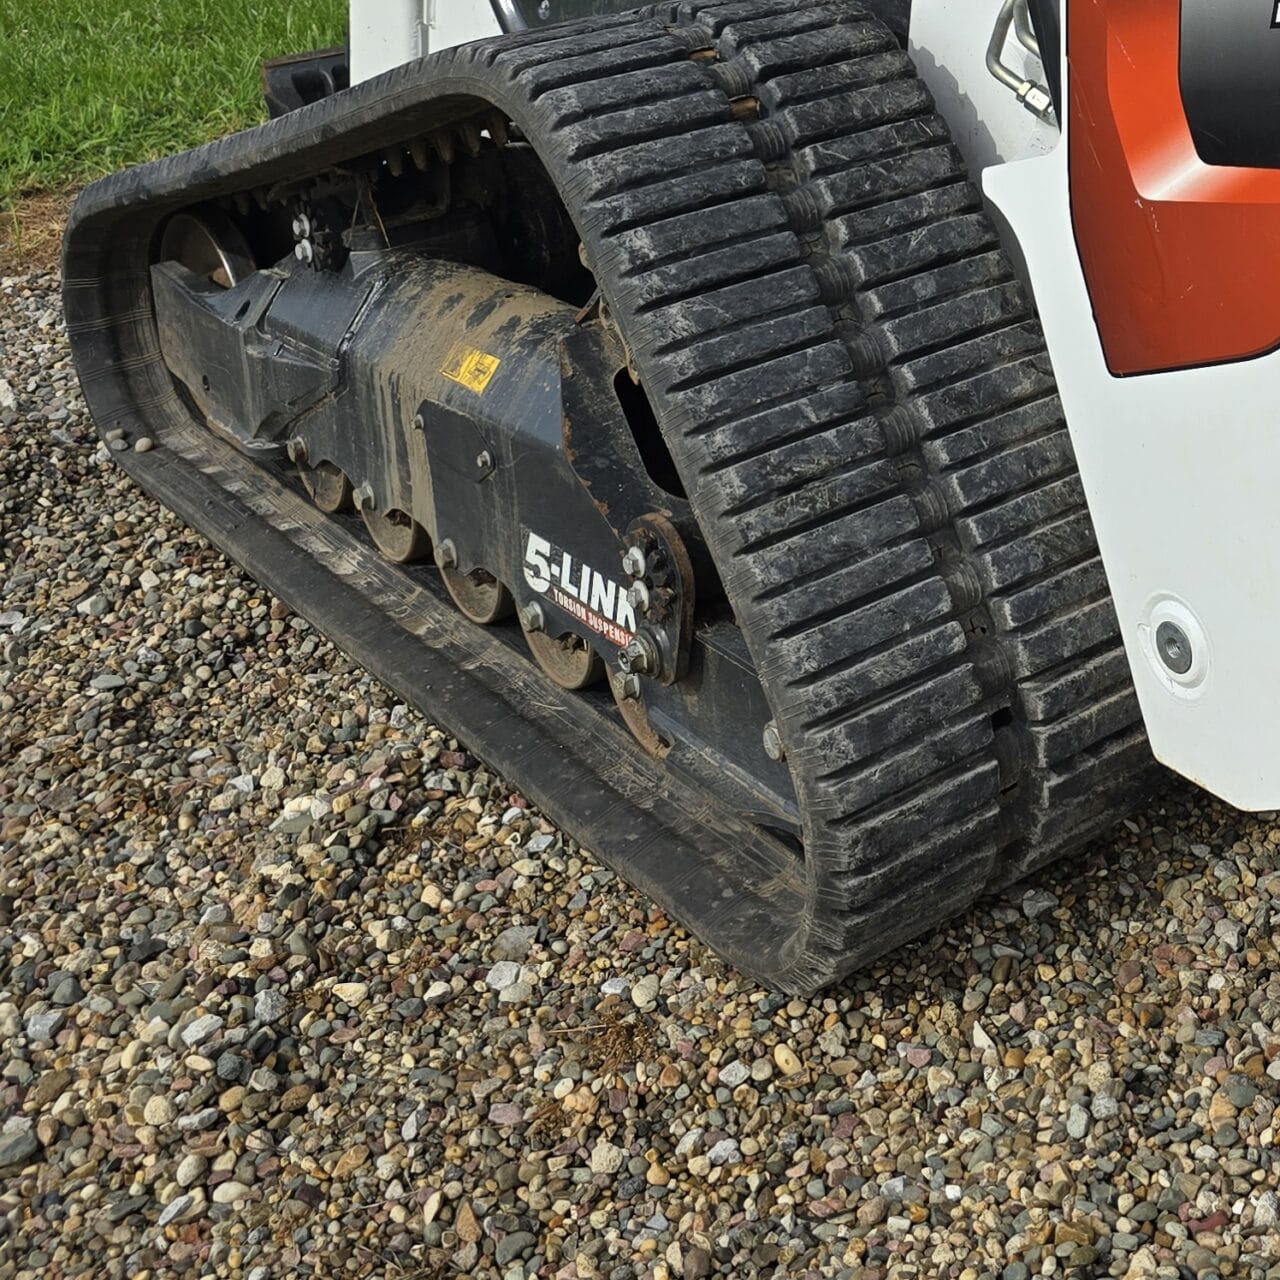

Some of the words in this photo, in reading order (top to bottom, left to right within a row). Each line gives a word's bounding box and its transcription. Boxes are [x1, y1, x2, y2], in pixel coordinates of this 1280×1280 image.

[523, 531, 638, 634] 5-LINK
[552, 587, 587, 622] TORSION
[587, 610, 634, 647] SUSPENSI
